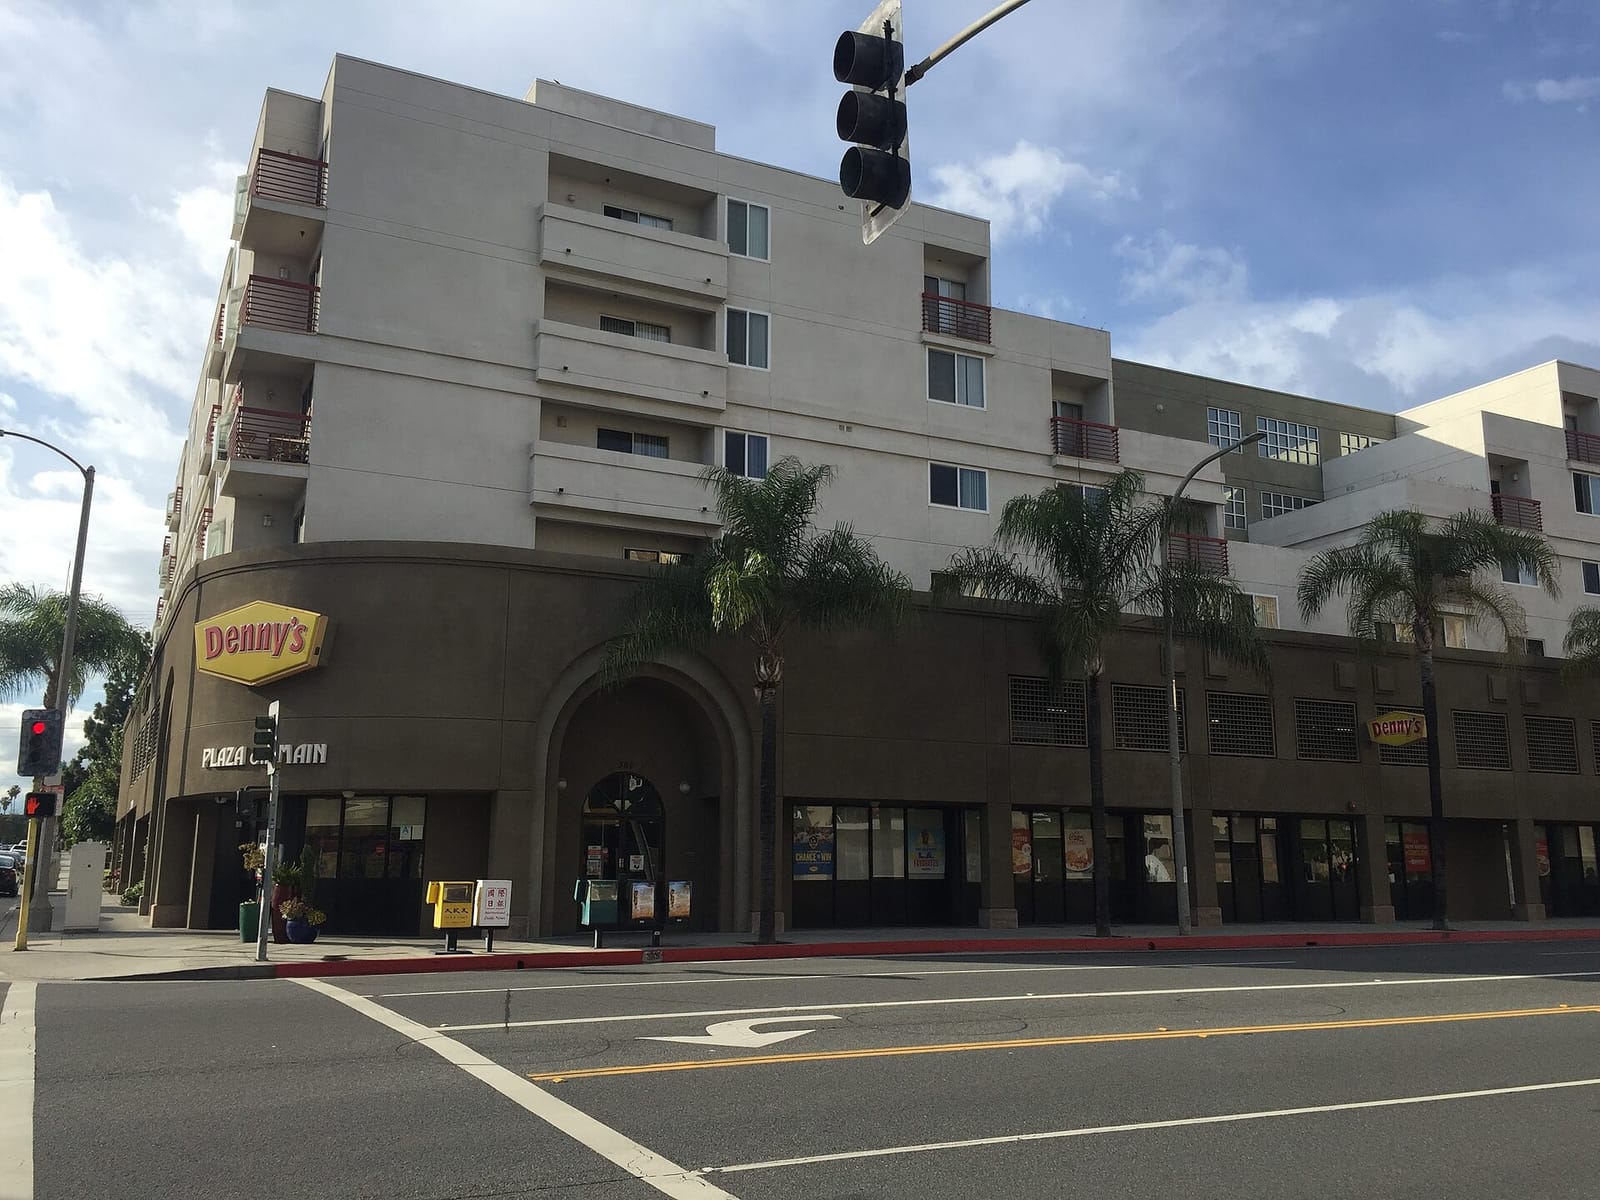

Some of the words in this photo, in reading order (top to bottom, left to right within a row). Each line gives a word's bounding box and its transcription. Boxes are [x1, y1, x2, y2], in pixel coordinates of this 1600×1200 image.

[205, 616, 307, 660] Denny's
[1372, 718, 1421, 737] Denny's
[202, 746, 247, 768] PLAZA
[279, 744, 328, 764] MAIN
